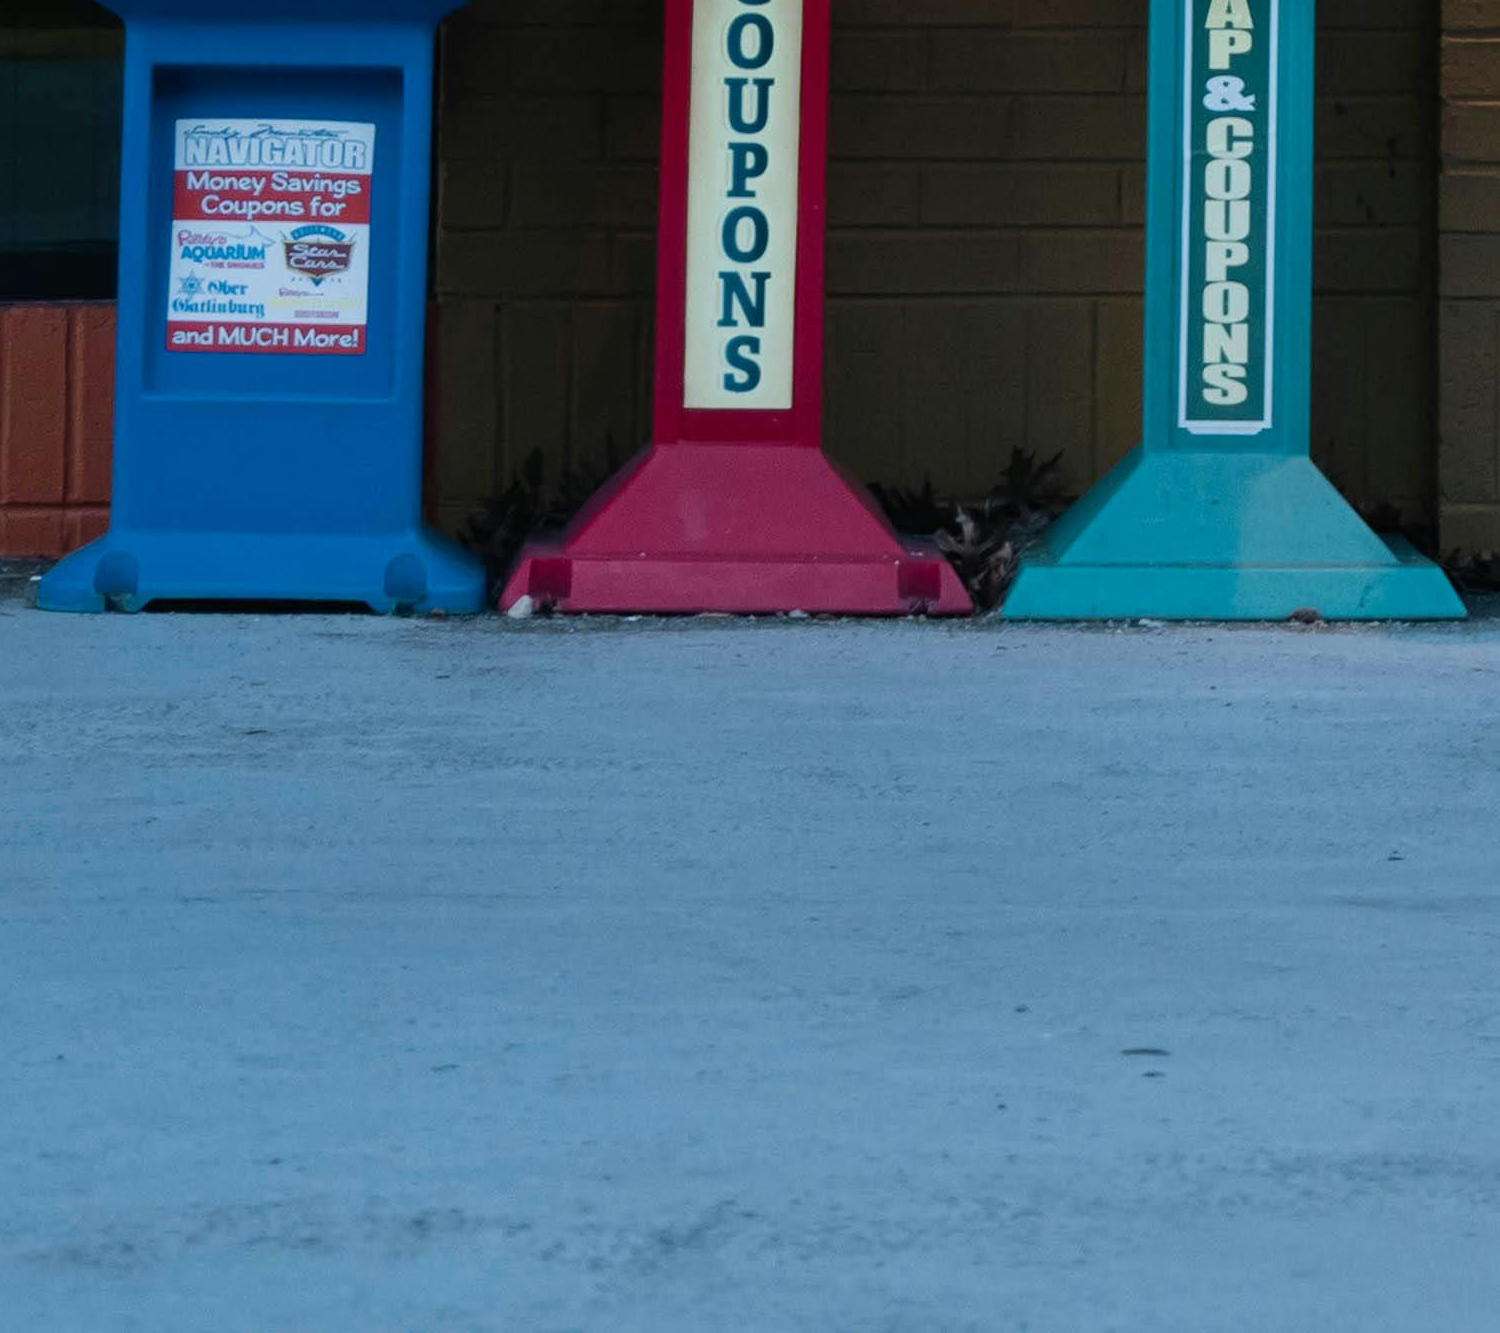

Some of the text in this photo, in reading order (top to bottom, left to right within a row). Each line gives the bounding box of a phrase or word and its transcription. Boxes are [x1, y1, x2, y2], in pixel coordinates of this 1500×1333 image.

[1203, 75, 1255, 112] &
[184, 136, 367, 169] NAVIGATOR
[186, 171, 362, 198] Money Savings
[201, 194, 347, 220] Coupons for
[180, 244, 265, 262] AQUARIUM
[288, 244, 347, 257] Star
[289, 256, 345, 269] Cars
[1202, 116, 1254, 405] COUPONS
[172, 326, 359, 348] and MUCH More!
